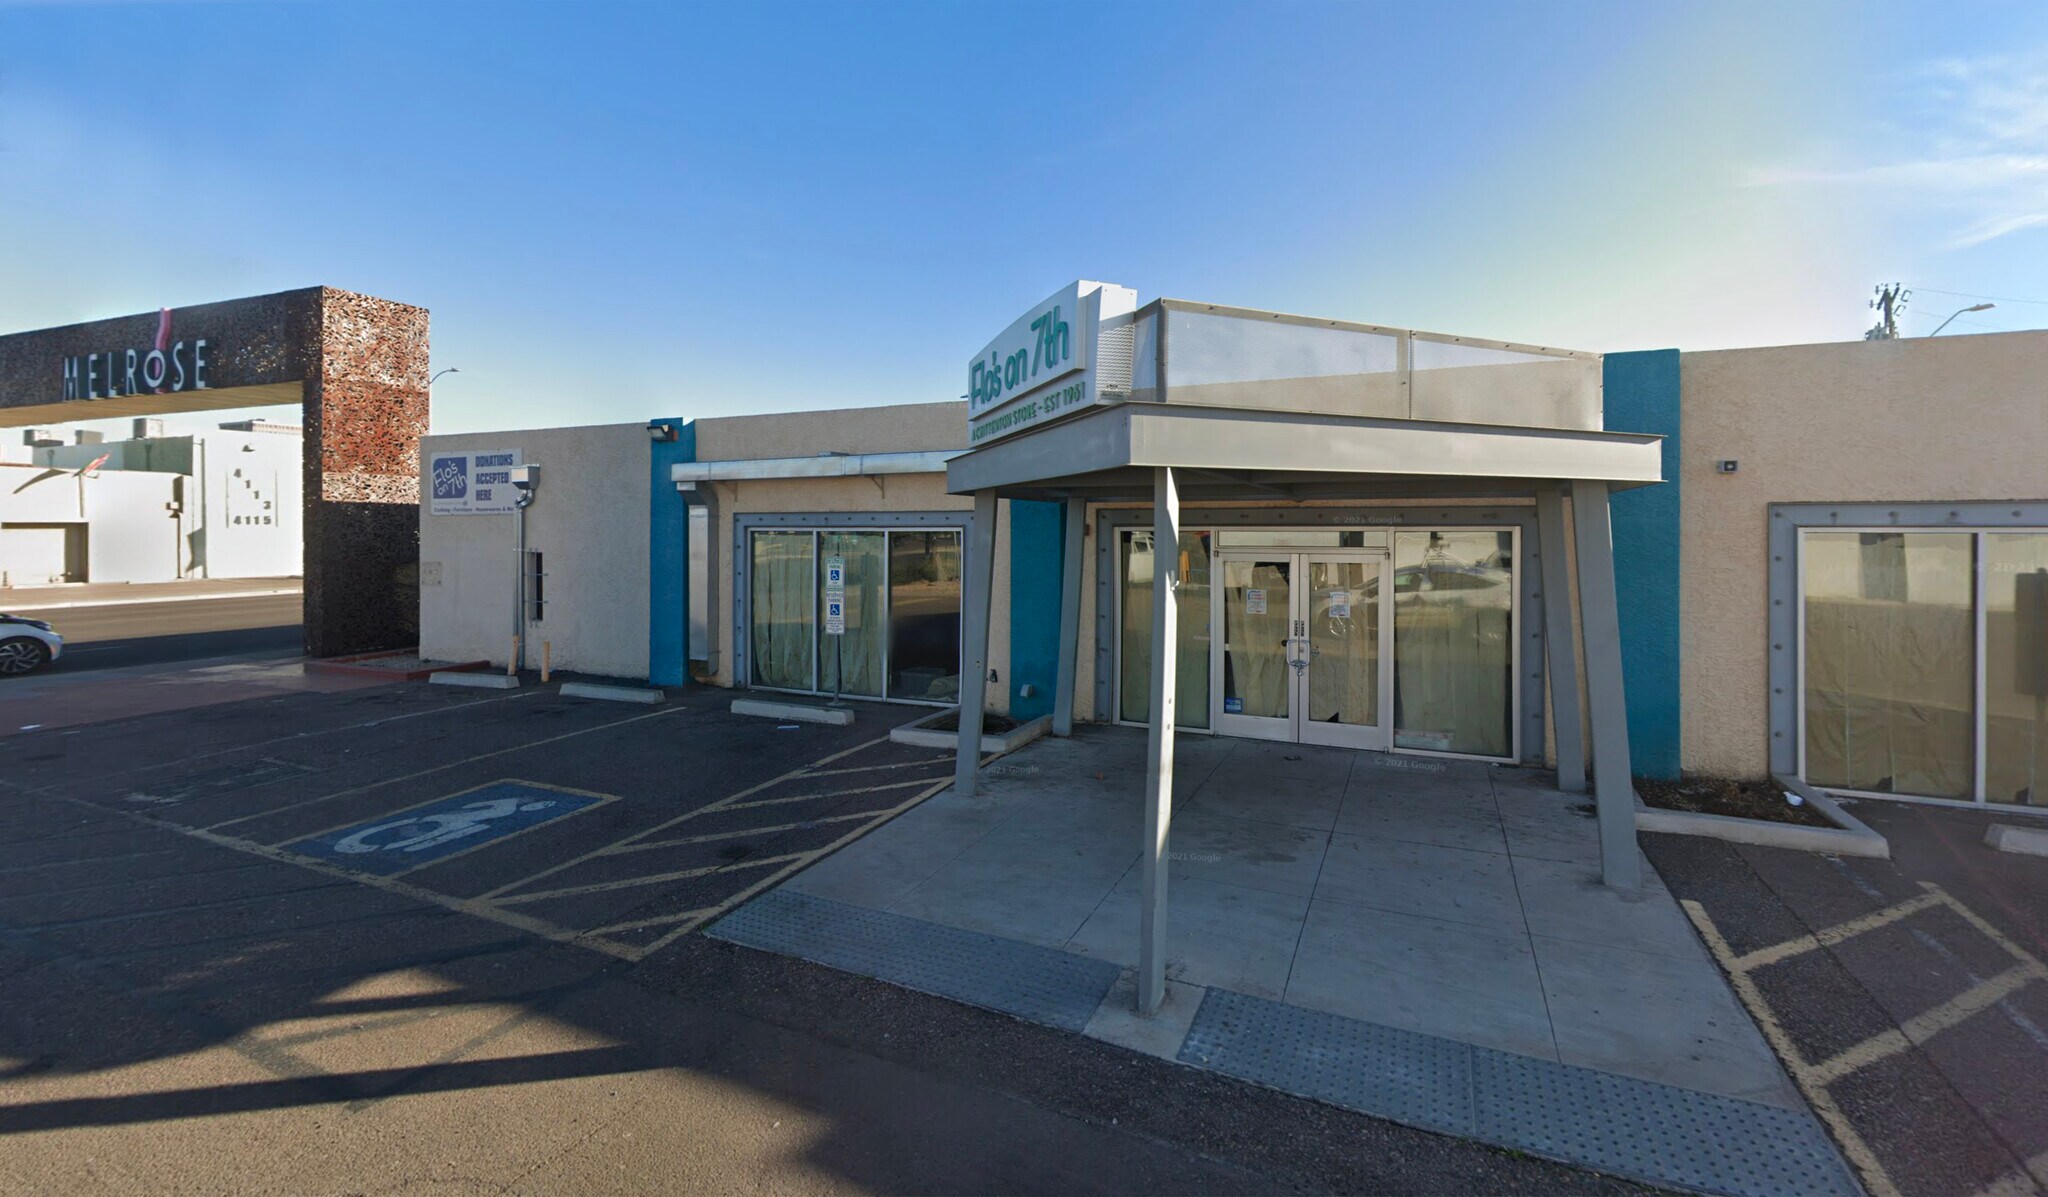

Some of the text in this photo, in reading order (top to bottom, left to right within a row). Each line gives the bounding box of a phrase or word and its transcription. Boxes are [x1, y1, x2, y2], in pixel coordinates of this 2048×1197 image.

[971, 305, 1069, 409] Flo's on 7th
[63, 340, 206, 401] MELROSE
[1012, 402, 1037, 424] STORE
[1043, 392, 1061, 413] EST
[475, 454, 513, 467] DONATIONS
[433, 461, 458, 487] Flo's
[437, 473, 467, 495] on 7th
[476, 472, 509, 484] ACCEPTED
[476, 489, 492, 501] HERE
[234, 515, 271, 525] 4115
